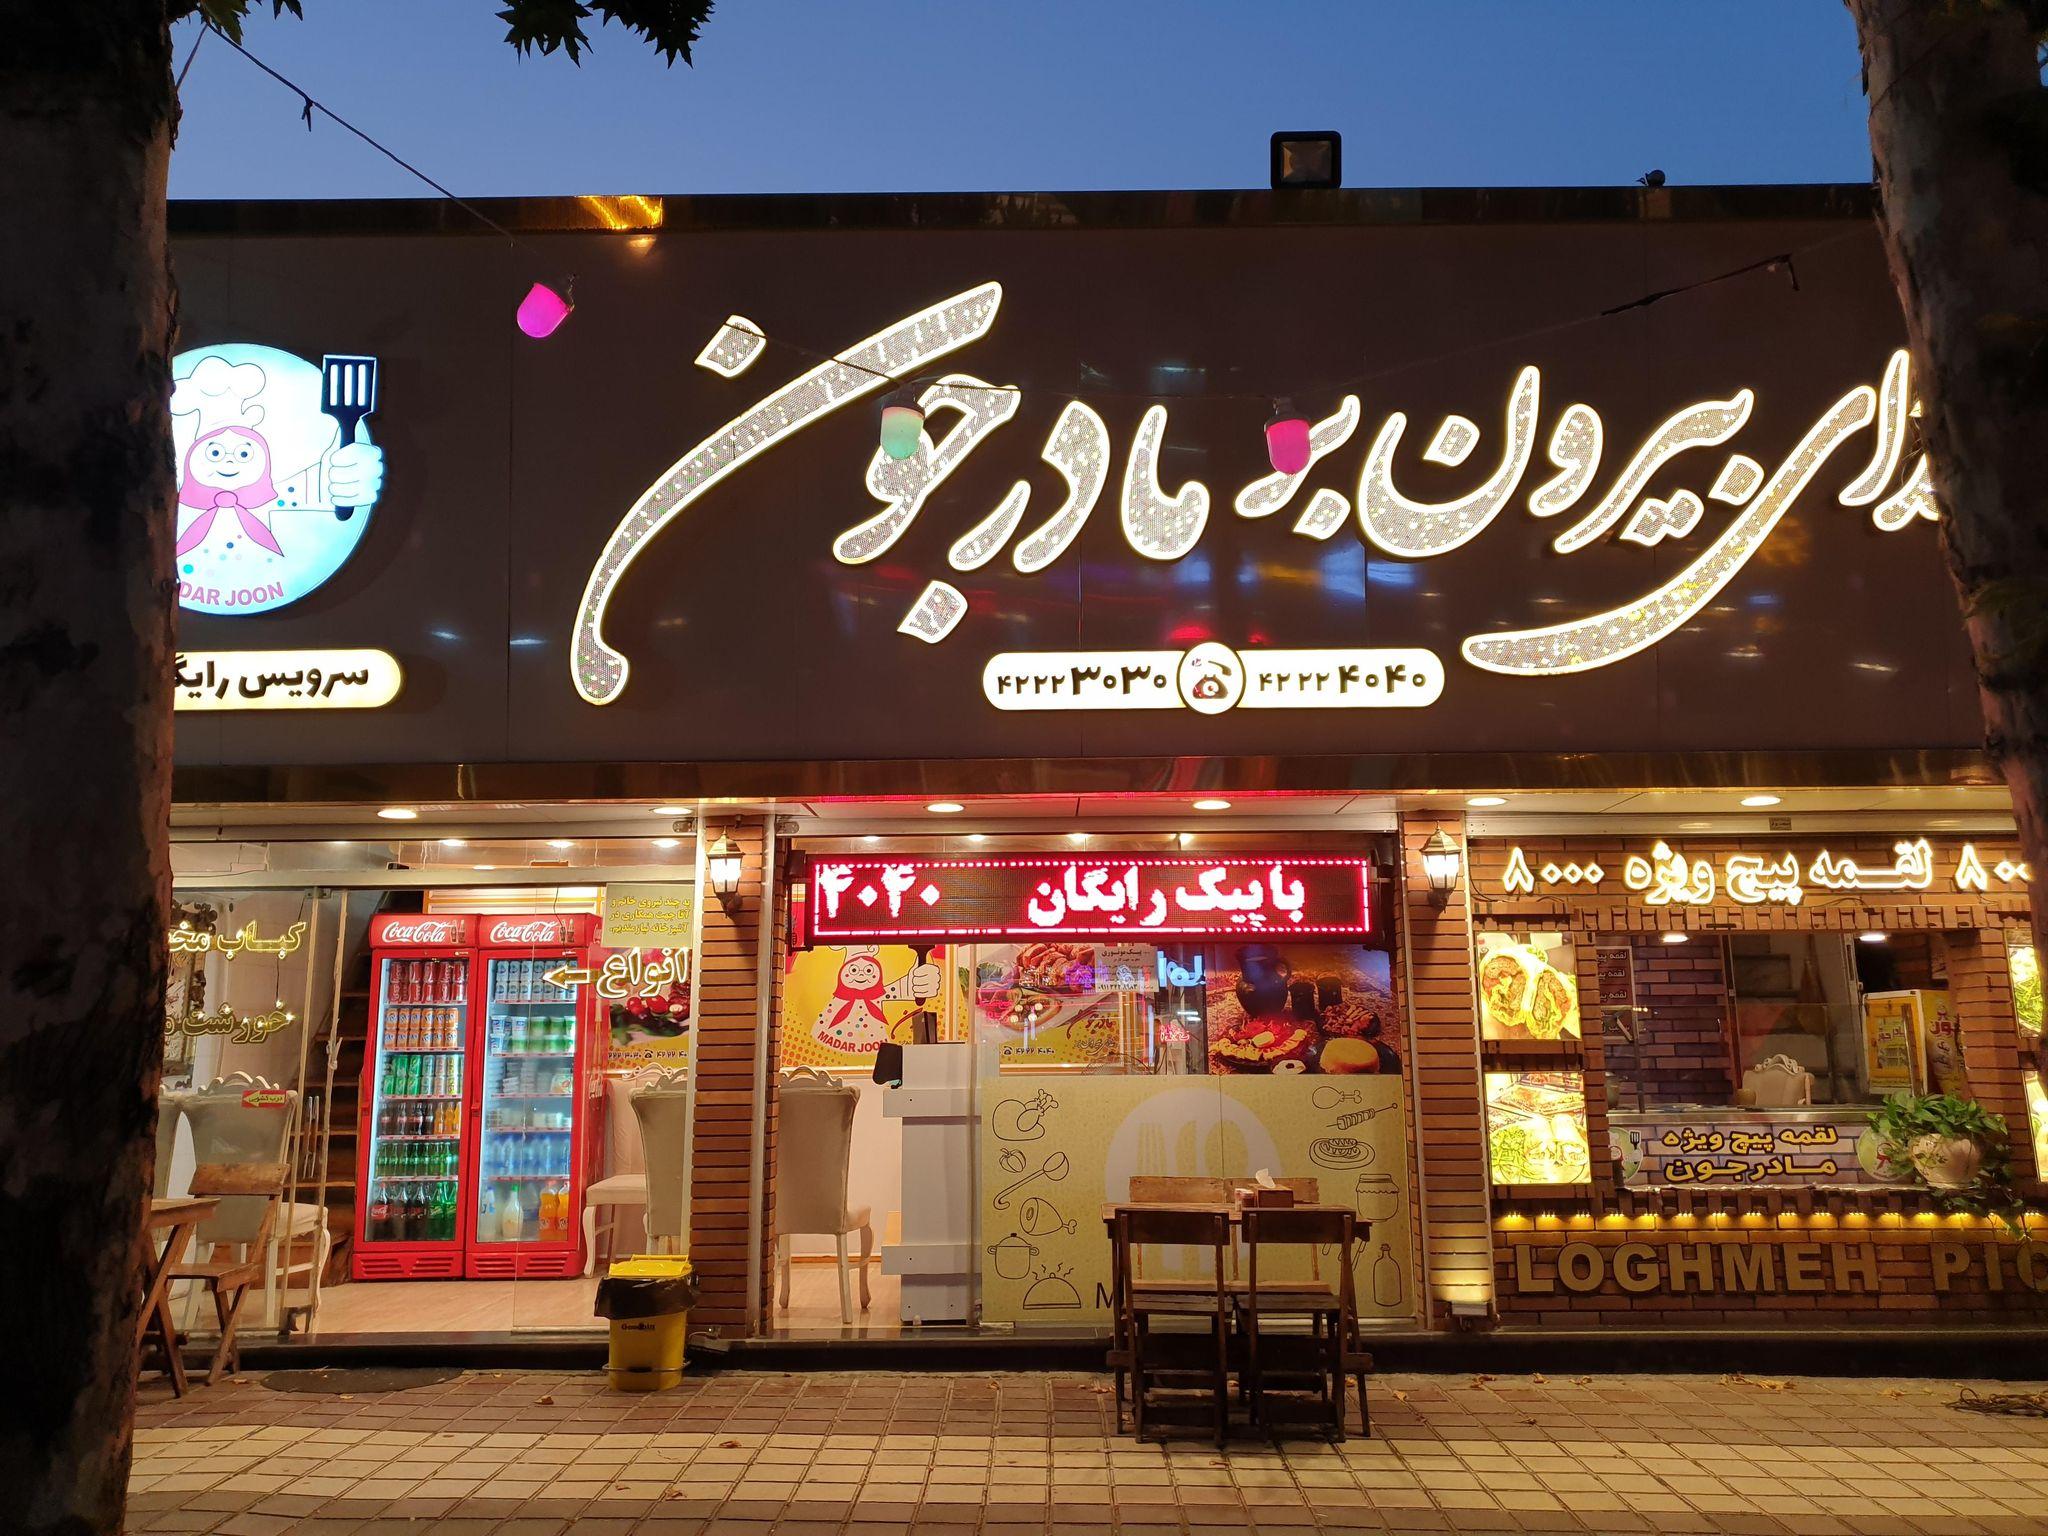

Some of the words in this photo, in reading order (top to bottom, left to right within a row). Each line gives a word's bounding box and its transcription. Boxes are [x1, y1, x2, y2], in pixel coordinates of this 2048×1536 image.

[179, 581, 220, 606] DAR
[224, 582, 285, 607] JOON
[174, 654, 230, 700] رایگ
[238, 667, 369, 699] سرویس
[1502, 846, 1605, 892] ۸۰۰۰
[1624, 840, 1716, 905] ویژه
[1725, 852, 1804, 905] پیچ
[1809, 838, 1934, 889] لقمه
[819, 864, 941, 918] ۴۰۴۰
[1028, 864, 1167, 927] رایگان
[1176, 866, 1266, 928] پیک
[1269, 864, 1305, 922] با
[216, 919, 307, 960] کباب
[381, 920, 454, 943] Coca-Cola
[489, 920, 560, 943] Coca-Cola
[596, 945, 690, 999] انواع
[817, 1030, 856, 1052] MADAR
[1662, 1127, 1725, 1153] ویژه
[1729, 1130, 1776, 1155] پیچ
[1779, 1125, 1839, 1147] لقمه
[1515, 1241, 1880, 1294] LOGHMEH
